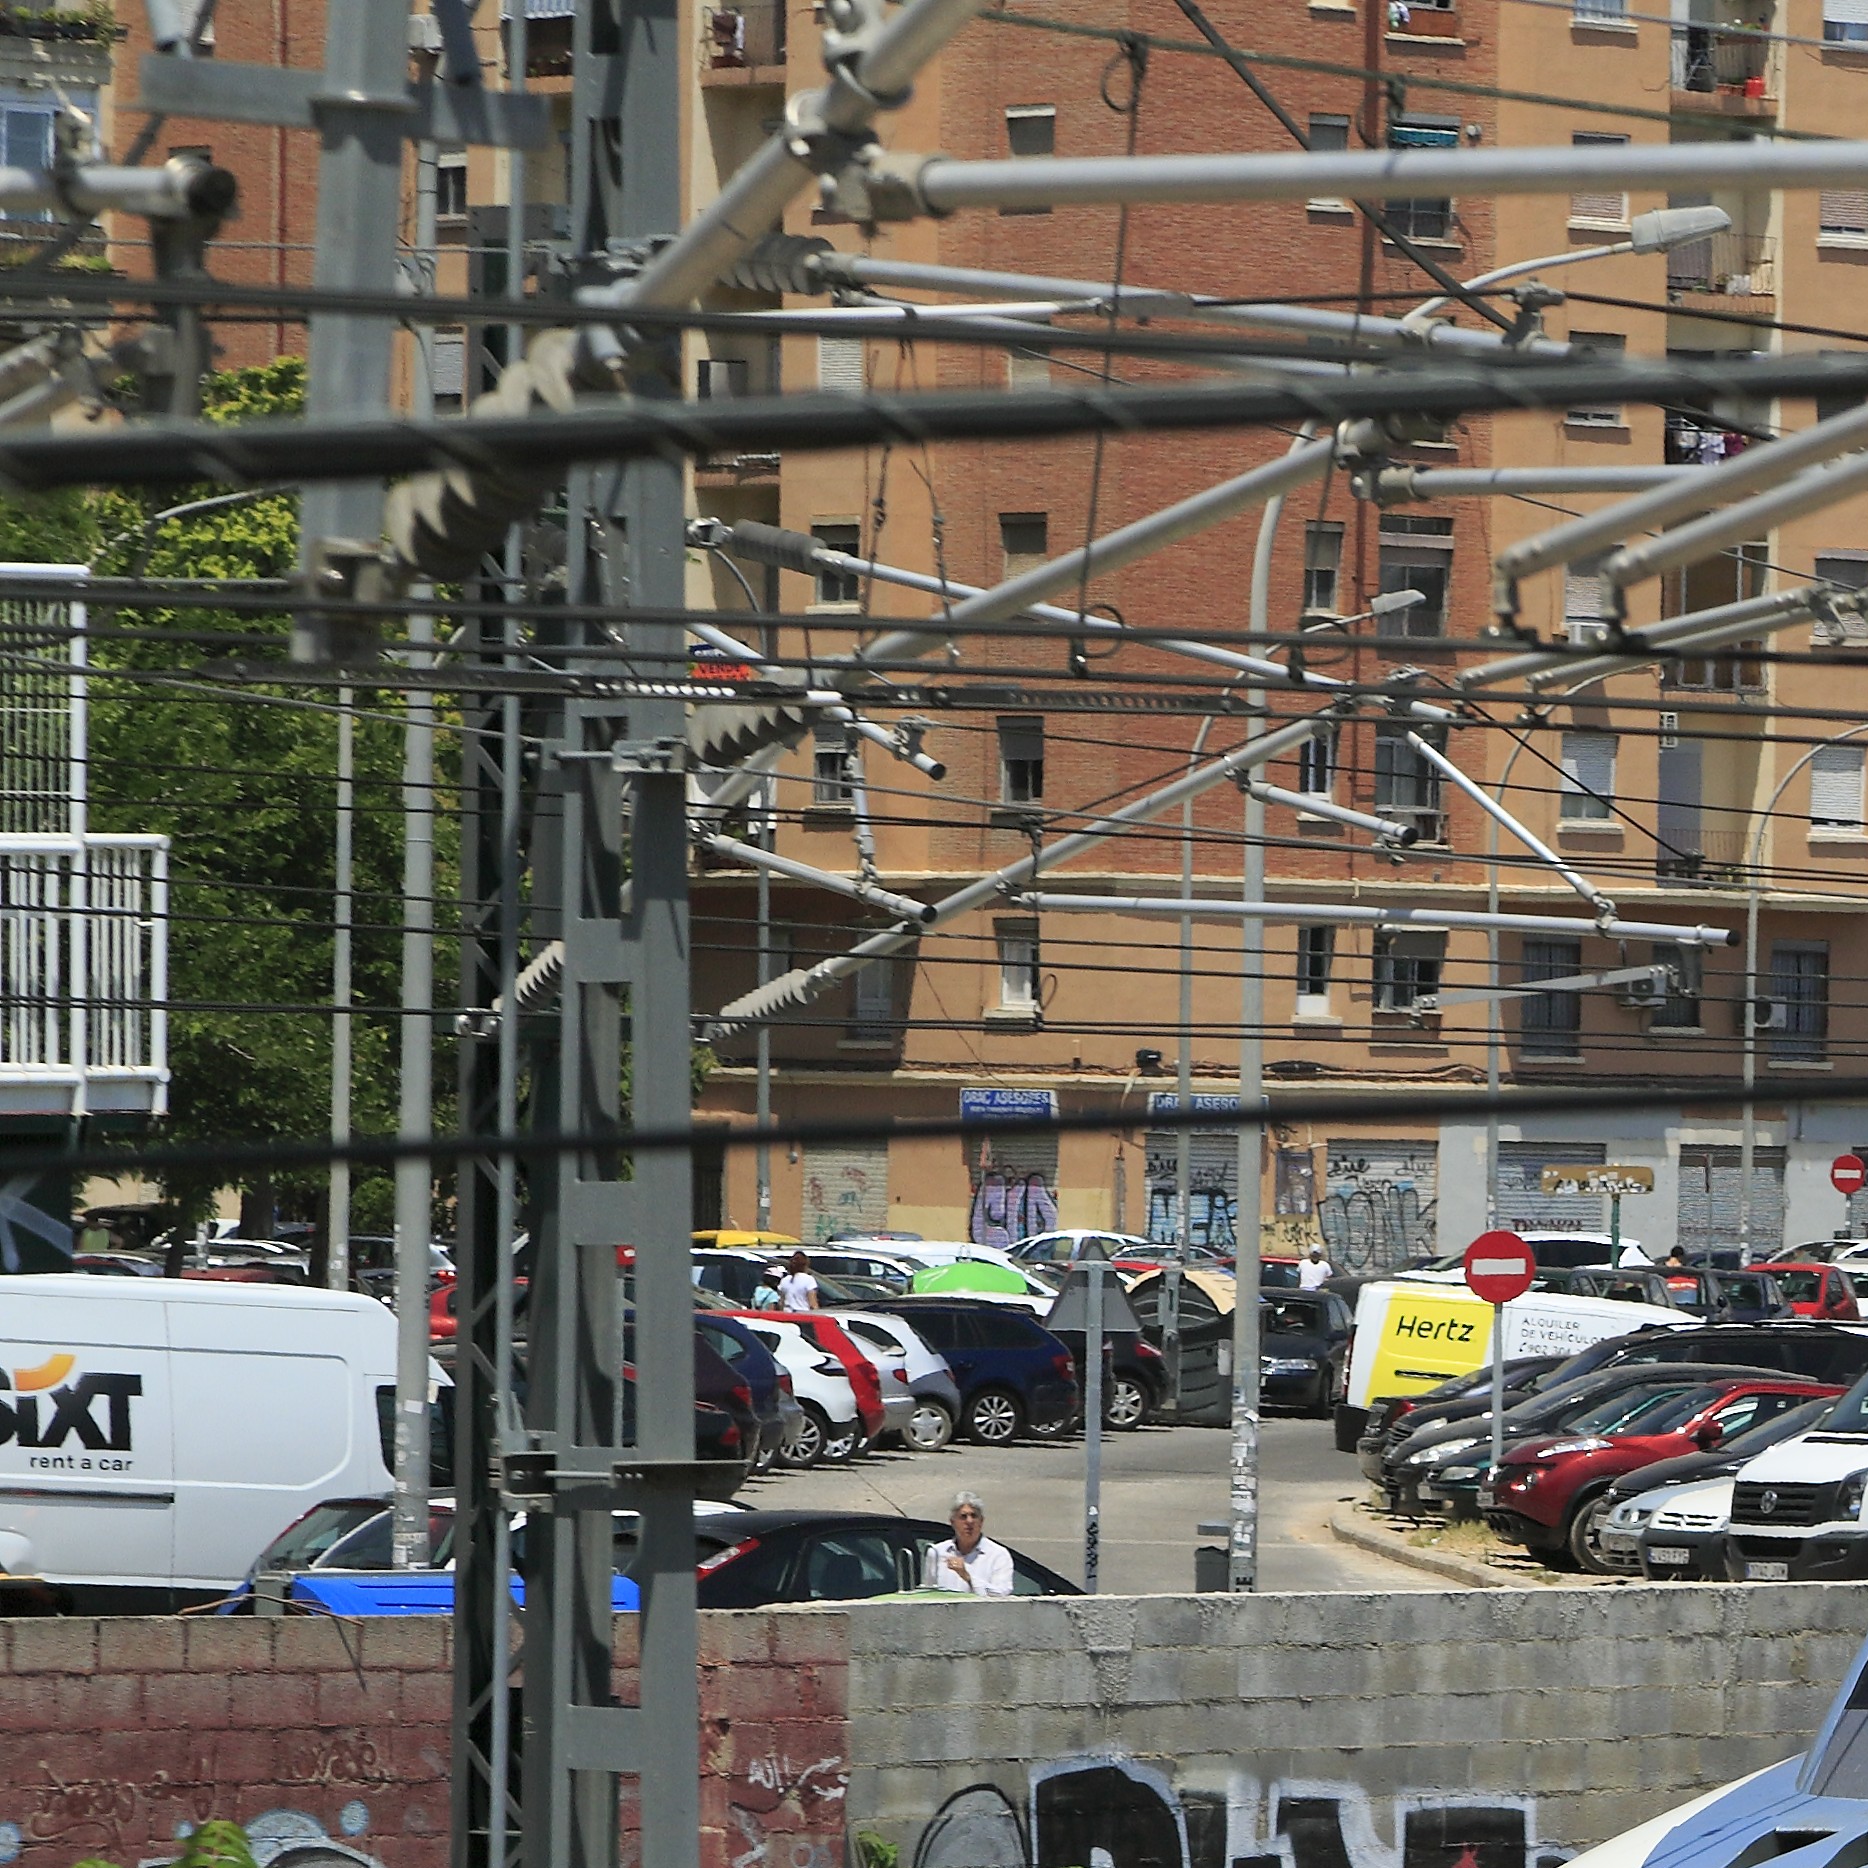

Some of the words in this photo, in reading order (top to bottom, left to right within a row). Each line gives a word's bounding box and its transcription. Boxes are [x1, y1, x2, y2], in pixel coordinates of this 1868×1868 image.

[1195, 1098, 1242, 1110] ASESO
[1395, 1315, 1476, 1343] Hertz
[1521, 1328, 1536, 1339] DE
[1540, 1330, 1605, 1345] VEHÍCULO
[30, 1455, 76, 1469] rent
[81, 1459, 92, 1470] a
[99, 1459, 134, 1471] car
